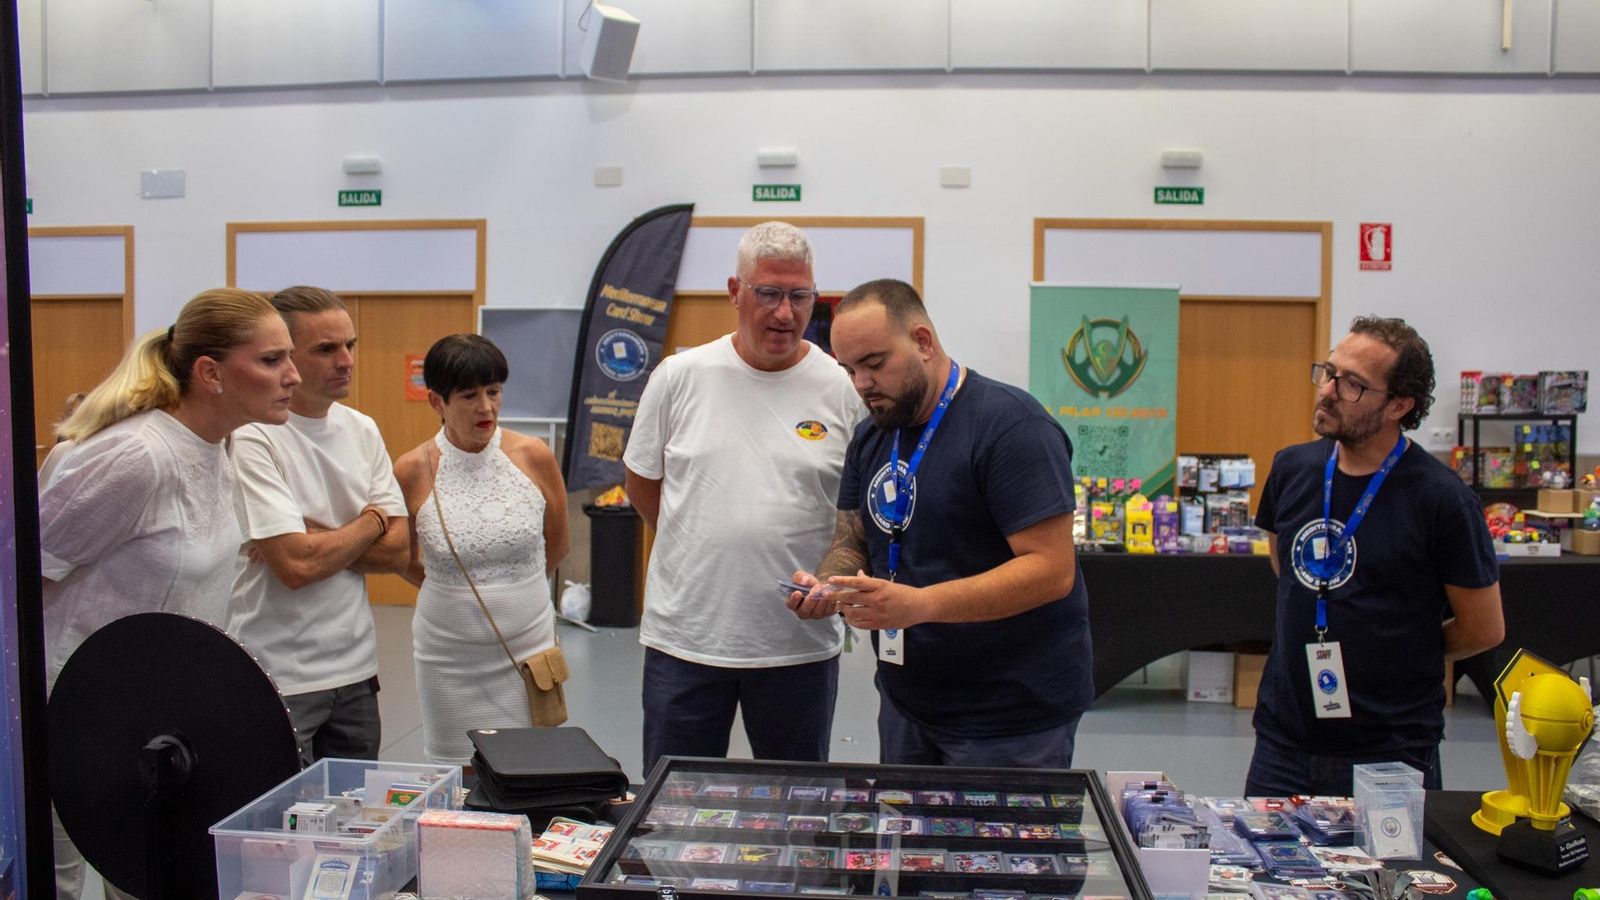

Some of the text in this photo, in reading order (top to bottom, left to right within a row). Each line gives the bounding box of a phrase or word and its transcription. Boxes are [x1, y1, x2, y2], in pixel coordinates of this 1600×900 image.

[340, 192, 378, 205] SALIDA
[755, 186, 796, 199] SALIDA
[1157, 190, 1199, 202] SALIDA
[606, 303, 656, 326] Card Show
[874, 512, 891, 529] CARD
